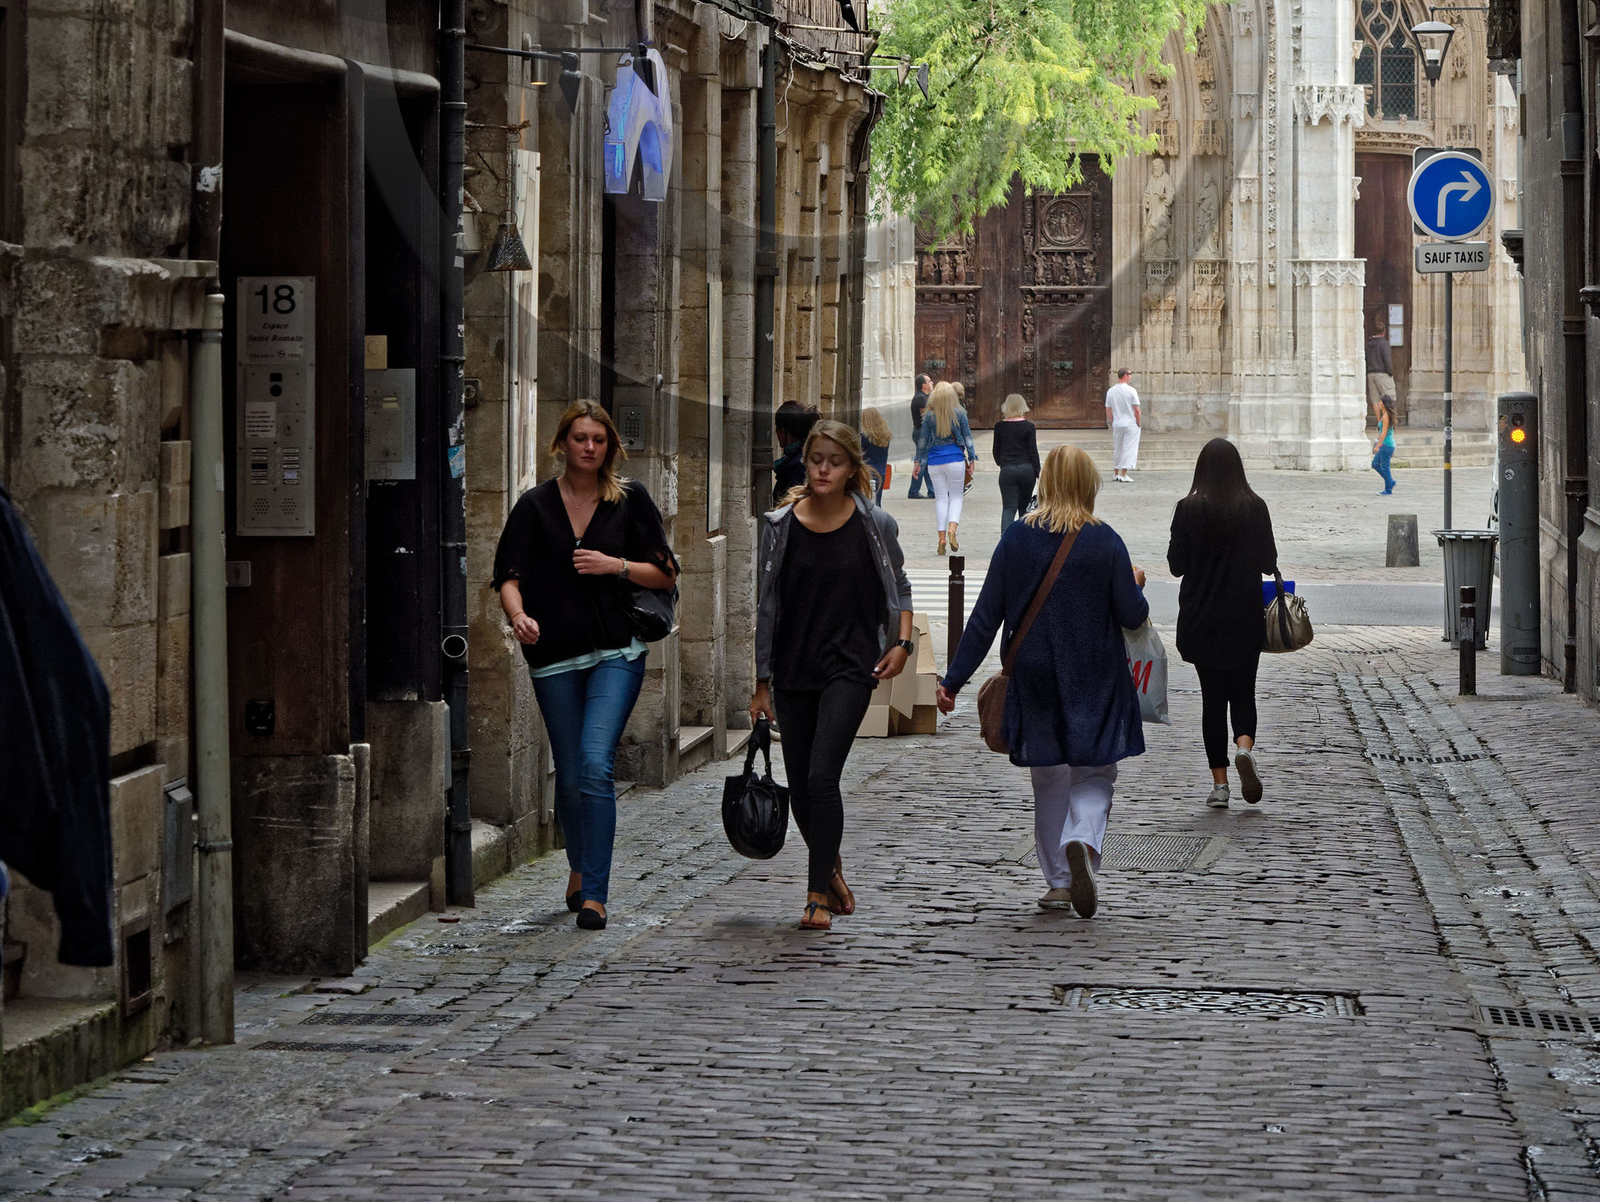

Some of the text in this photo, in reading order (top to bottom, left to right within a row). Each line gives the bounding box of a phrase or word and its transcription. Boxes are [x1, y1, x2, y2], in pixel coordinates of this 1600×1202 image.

[1424, 250, 1484, 264] SAUF TAXIS
[254, 284, 296, 315] 18
[262, 322, 289, 331] Espace
[248, 334, 304, 343] Saint Romain
